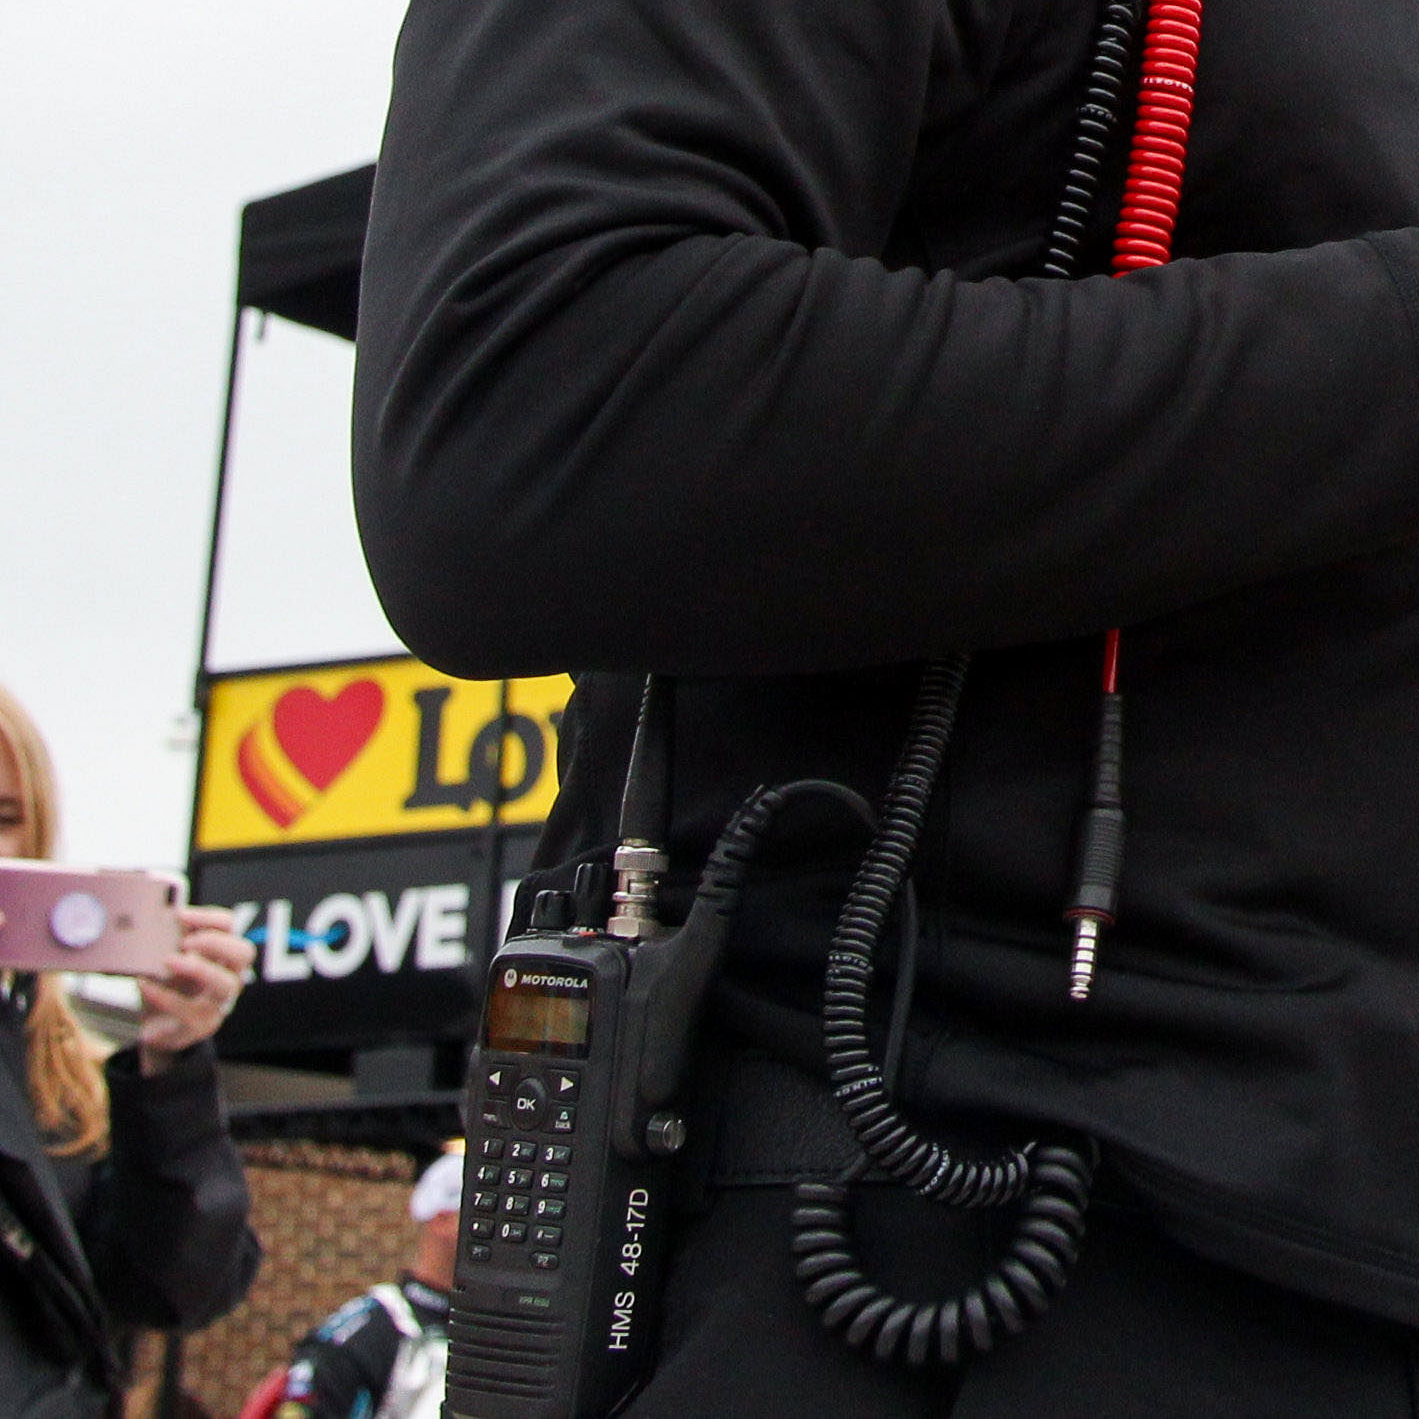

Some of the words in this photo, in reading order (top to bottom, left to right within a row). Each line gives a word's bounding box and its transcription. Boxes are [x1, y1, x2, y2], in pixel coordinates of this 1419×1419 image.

[521, 974, 589, 989] MOTOROLA
[516, 1097, 537, 1111] OK
[483, 1140, 490, 1154] 1
[511, 1143, 521, 1157] 2
[545, 1147, 554, 1161] 3
[477, 1166, 485, 1180] 4
[507, 1170, 517, 1184] 5
[541, 1173, 550, 1188] 6
[473, 1192, 482, 1206] 7
[505, 1196, 514, 1211] 8
[537, 1200, 546, 1214] 9
[501, 1223, 510, 1238] 0
[620, 1188, 649, 1276] 48-17D
[608, 1291, 636, 1350] HMS
